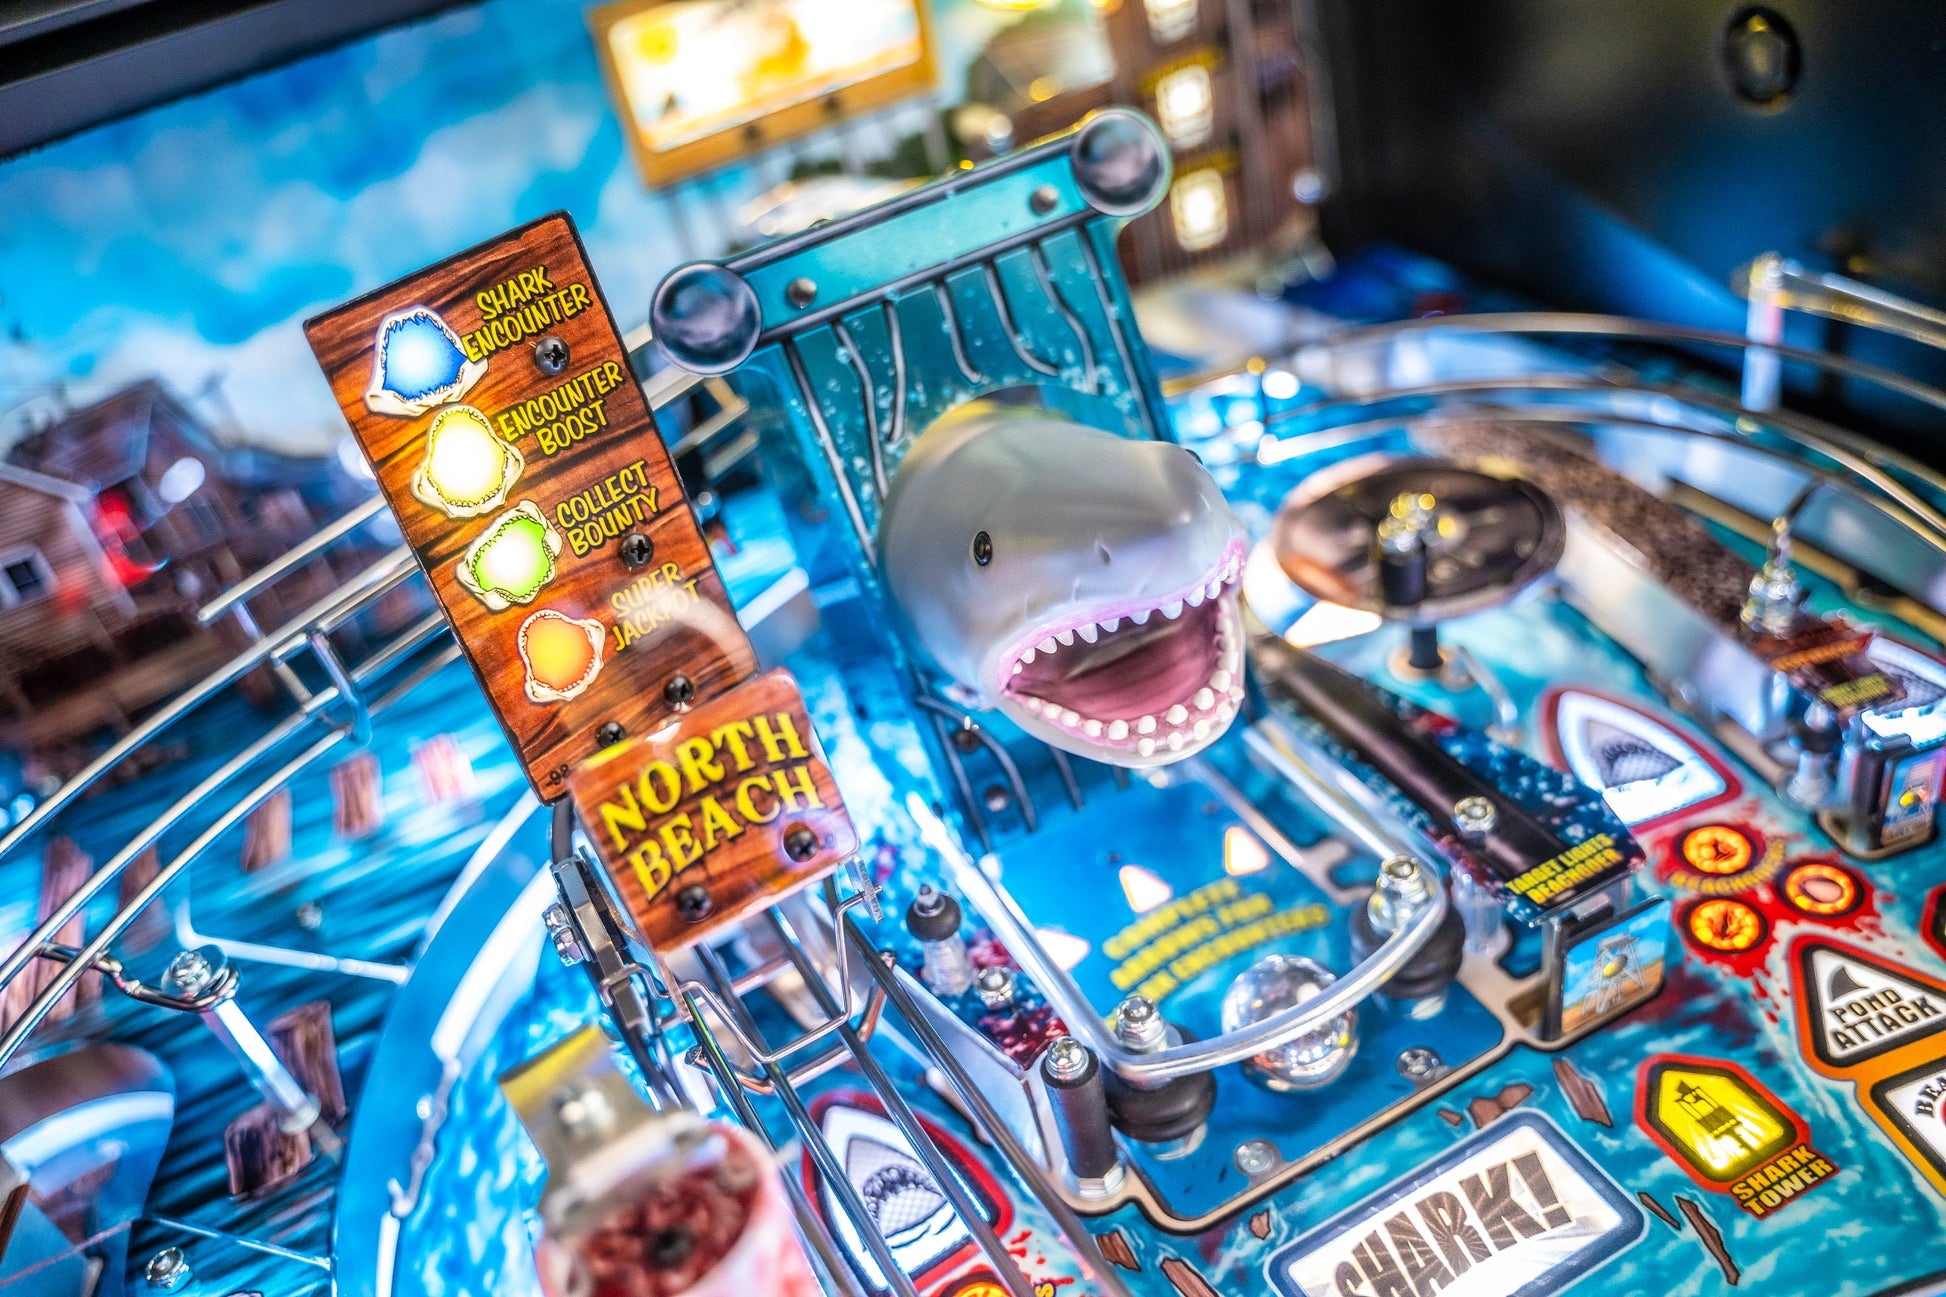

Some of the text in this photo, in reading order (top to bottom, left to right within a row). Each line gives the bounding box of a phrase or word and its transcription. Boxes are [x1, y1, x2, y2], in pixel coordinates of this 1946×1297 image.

[461, 283, 592, 363] ENCOUNTER
[475, 265, 555, 321] SHARK
[497, 361, 624, 442] ENCOUNTER
[535, 399, 609, 455] BOOST
[556, 460, 648, 529] COLLECT
[566, 487, 658, 557] BOUNTY
[610, 562, 682, 618] SUPER
[612, 579, 700, 652] JACKPOT
[599, 711, 809, 853] NORTH
[628, 765, 825, 901] BEACH
[1504, 833, 1615, 895] TARGET LIGHTS
[1525, 847, 1624, 904] BEACHGOER
[1830, 988, 1902, 1024] POND
[1831, 996, 1942, 1051] ATTACK
[1730, 1144, 1817, 1200] SHARK
[1743, 1158, 1834, 1216] TOWER
